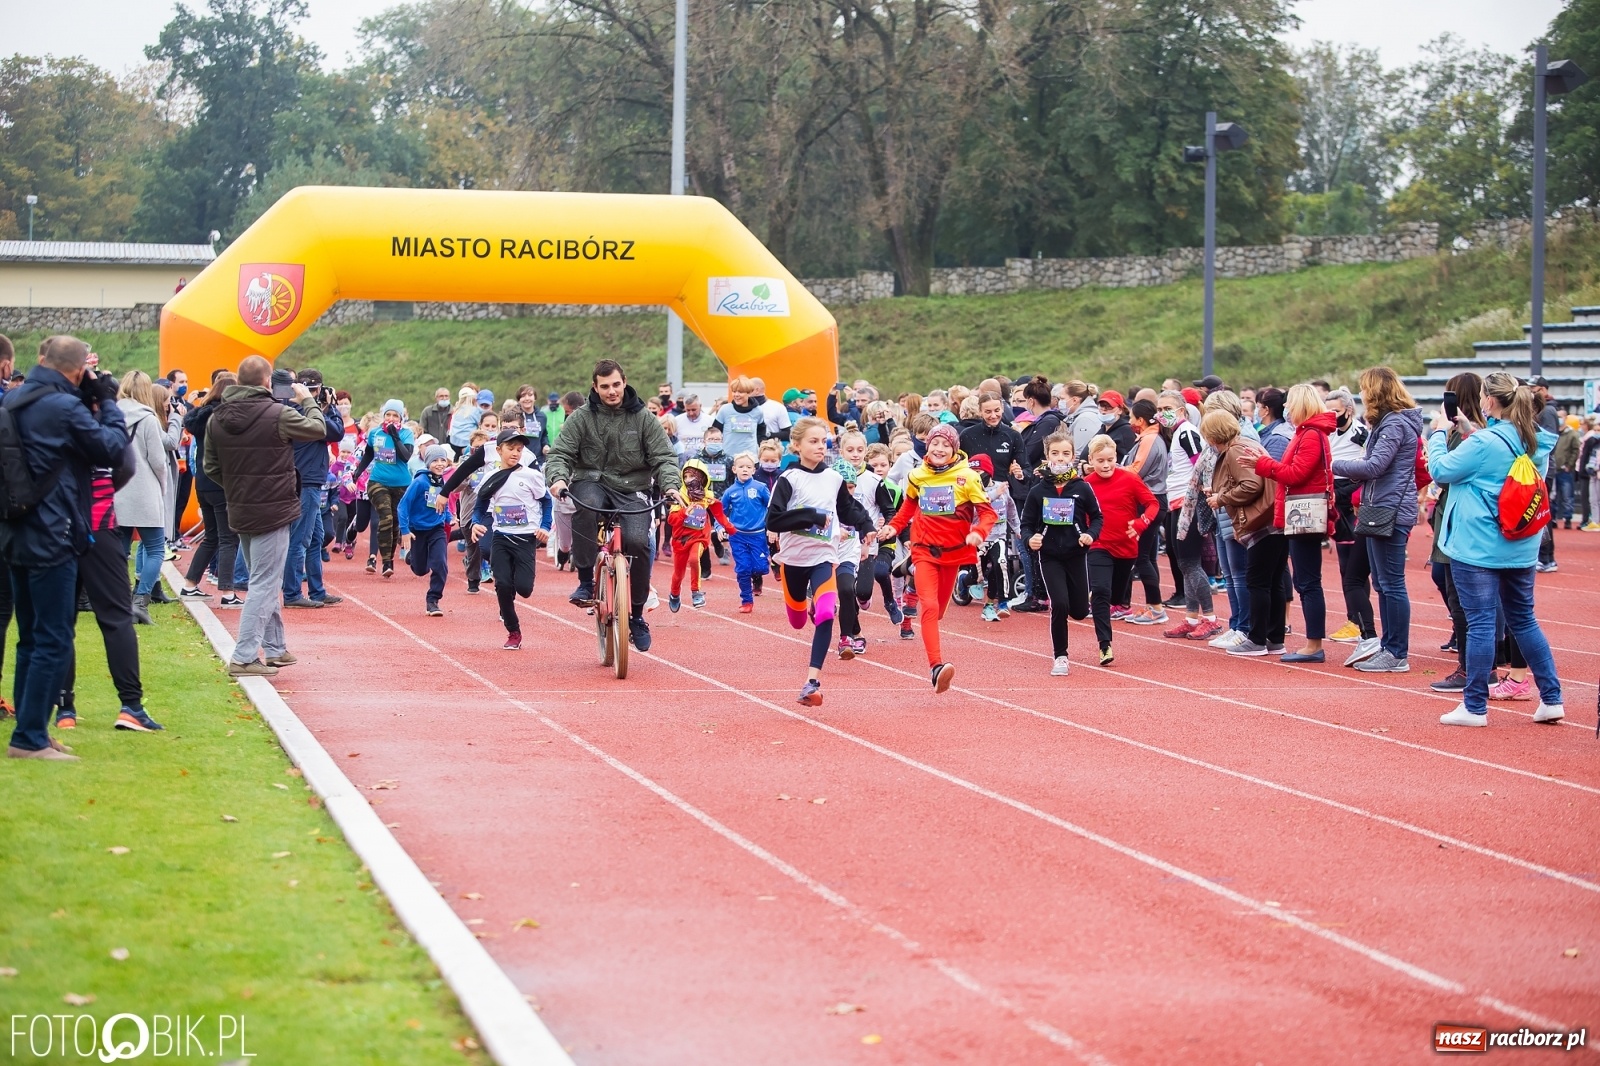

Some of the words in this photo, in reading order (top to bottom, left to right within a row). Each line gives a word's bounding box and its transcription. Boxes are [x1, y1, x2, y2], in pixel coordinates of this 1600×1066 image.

[391, 236, 491, 259] MIASTO
[500, 235, 635, 260] RACIBÓRZ
[938, 504, 952, 512] 216
[1523, 494, 1542, 522] ADAM
